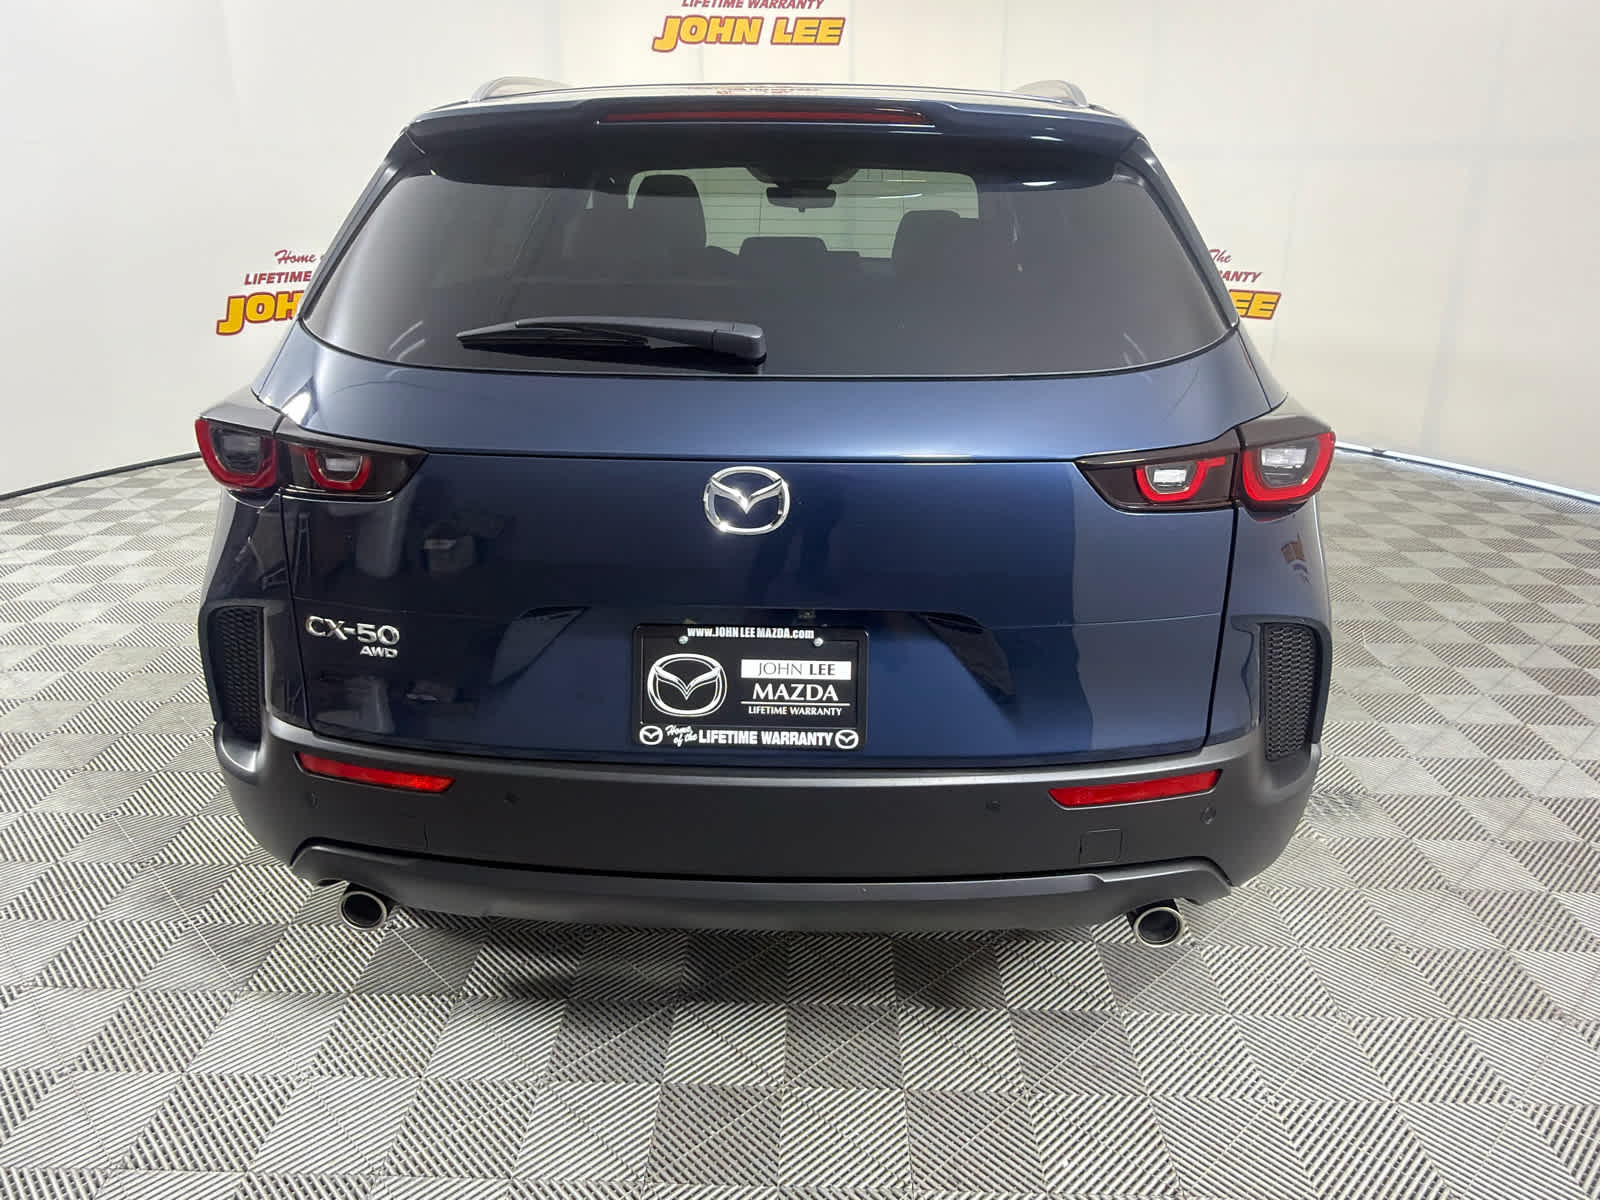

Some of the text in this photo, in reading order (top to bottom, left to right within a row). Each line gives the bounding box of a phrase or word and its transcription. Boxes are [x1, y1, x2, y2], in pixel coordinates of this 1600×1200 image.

[748, 0, 824, 9] WARRANTY
[652, 15, 846, 53] JOHN LEE
[274, 249, 317, 264] Home
[1208, 248, 1232, 263] The
[244, 271, 312, 285] LIFETIME
[1219, 270, 1263, 283] ANTY
[305, 615, 400, 645] CX-50
[360, 645, 398, 658] AWD
[757, 662, 836, 676] JOHN LEE
[752, 683, 839, 701] MAZDA
[748, 706, 843, 716] LIFETIME WARRANTY
[665, 725, 693, 737] Home
[698, 729, 834, 746] LIFETIME WARRANTY
[673, 734, 698, 747] of the
